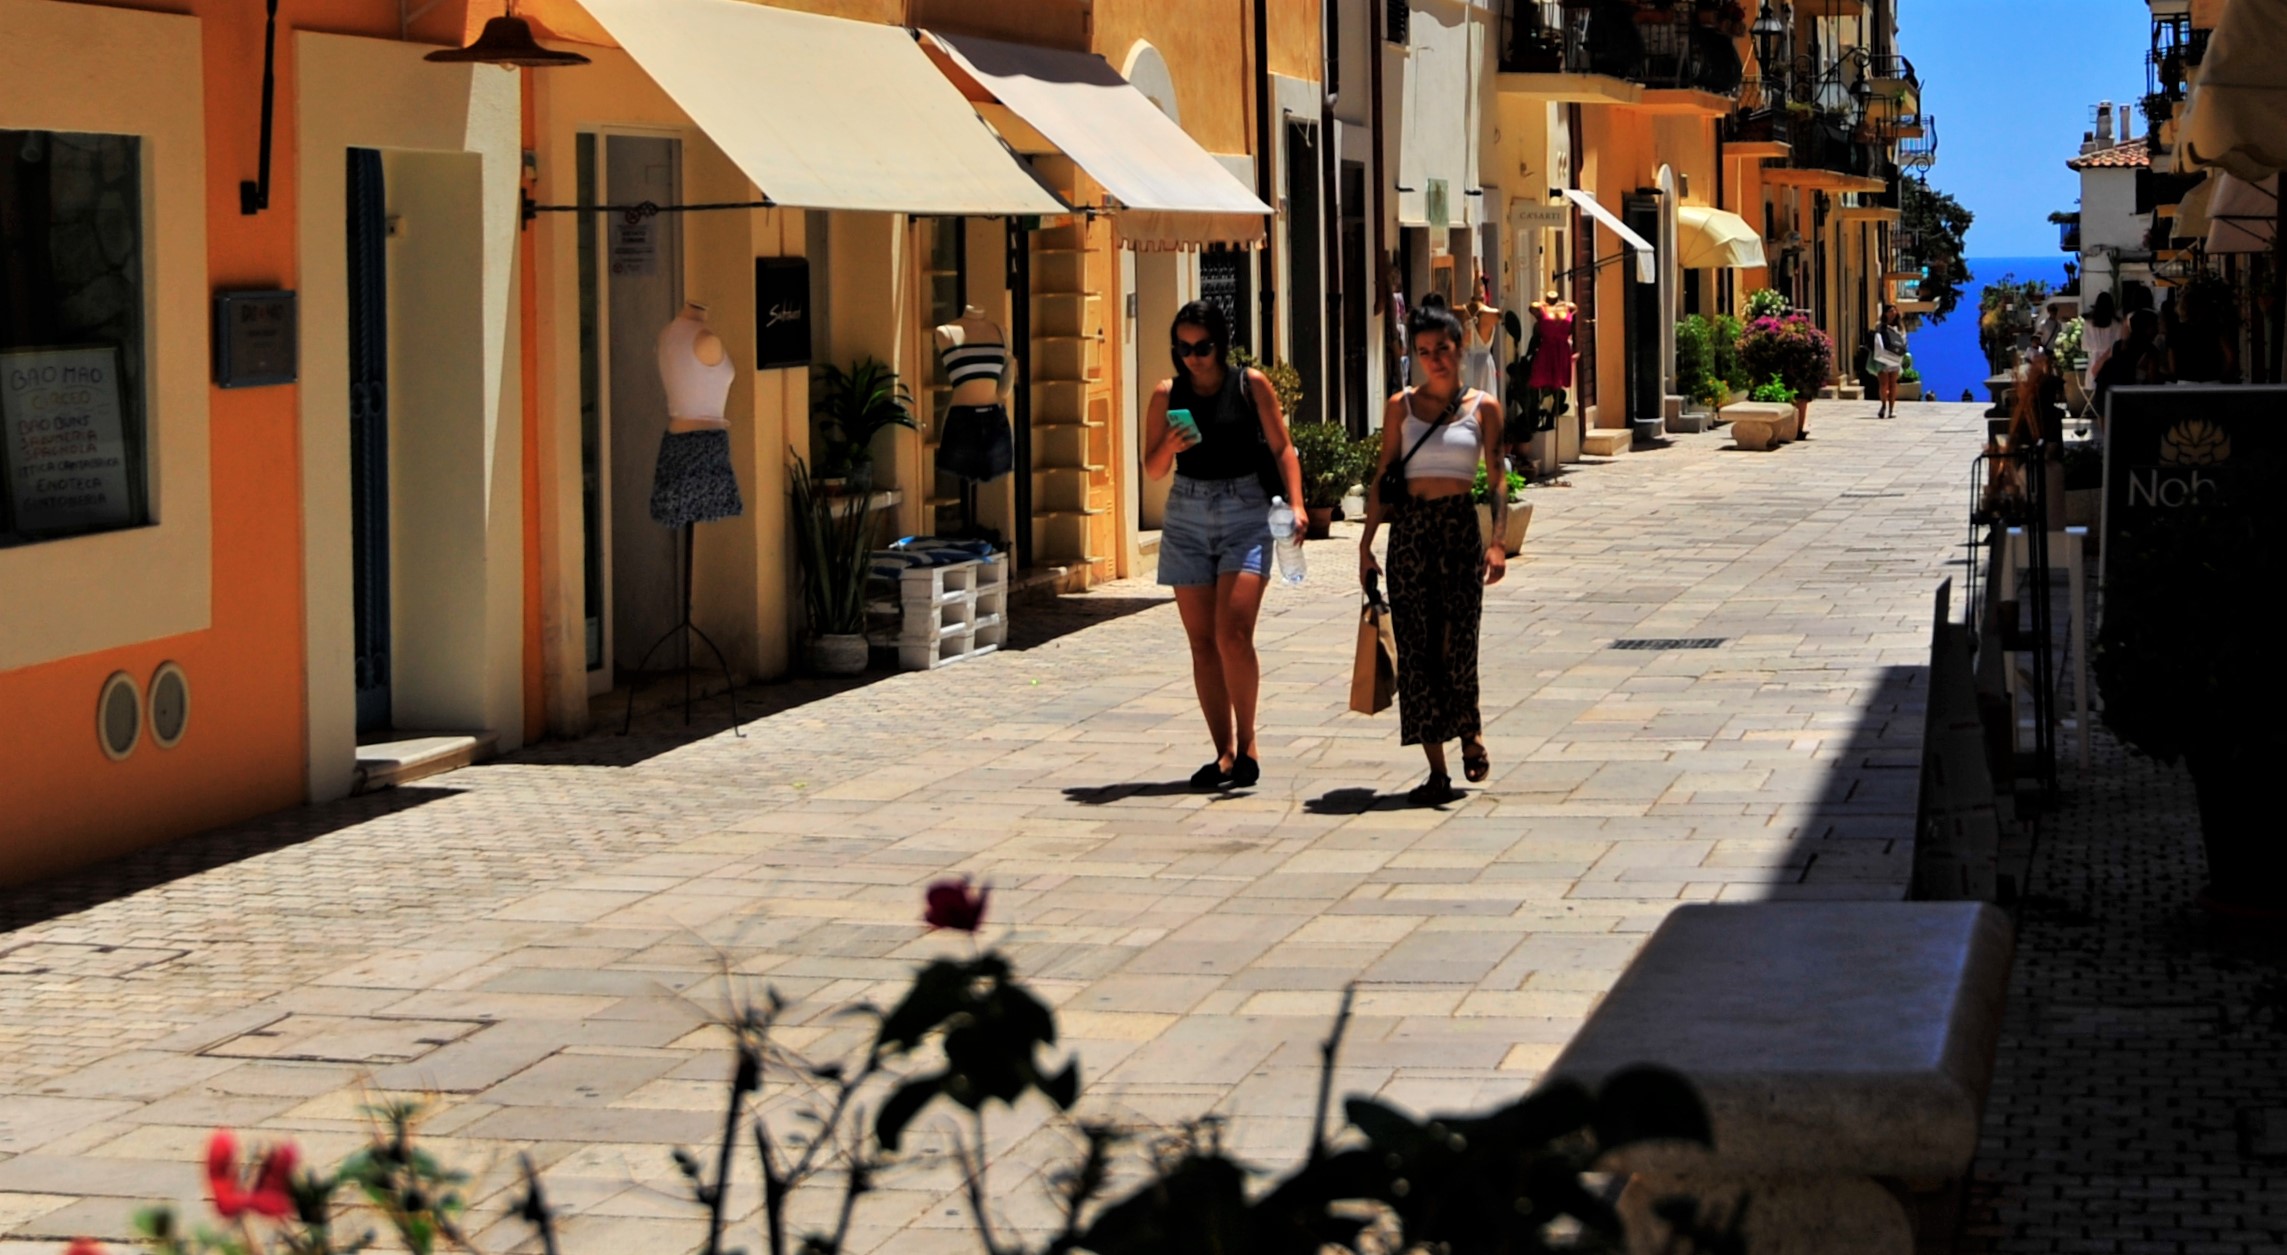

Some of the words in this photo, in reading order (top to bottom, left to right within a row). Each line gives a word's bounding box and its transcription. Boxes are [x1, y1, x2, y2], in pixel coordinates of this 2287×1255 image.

[10, 366, 57, 391] BAO
[62, 366, 104, 384] MAO
[36, 477, 103, 493] ENOTECA
